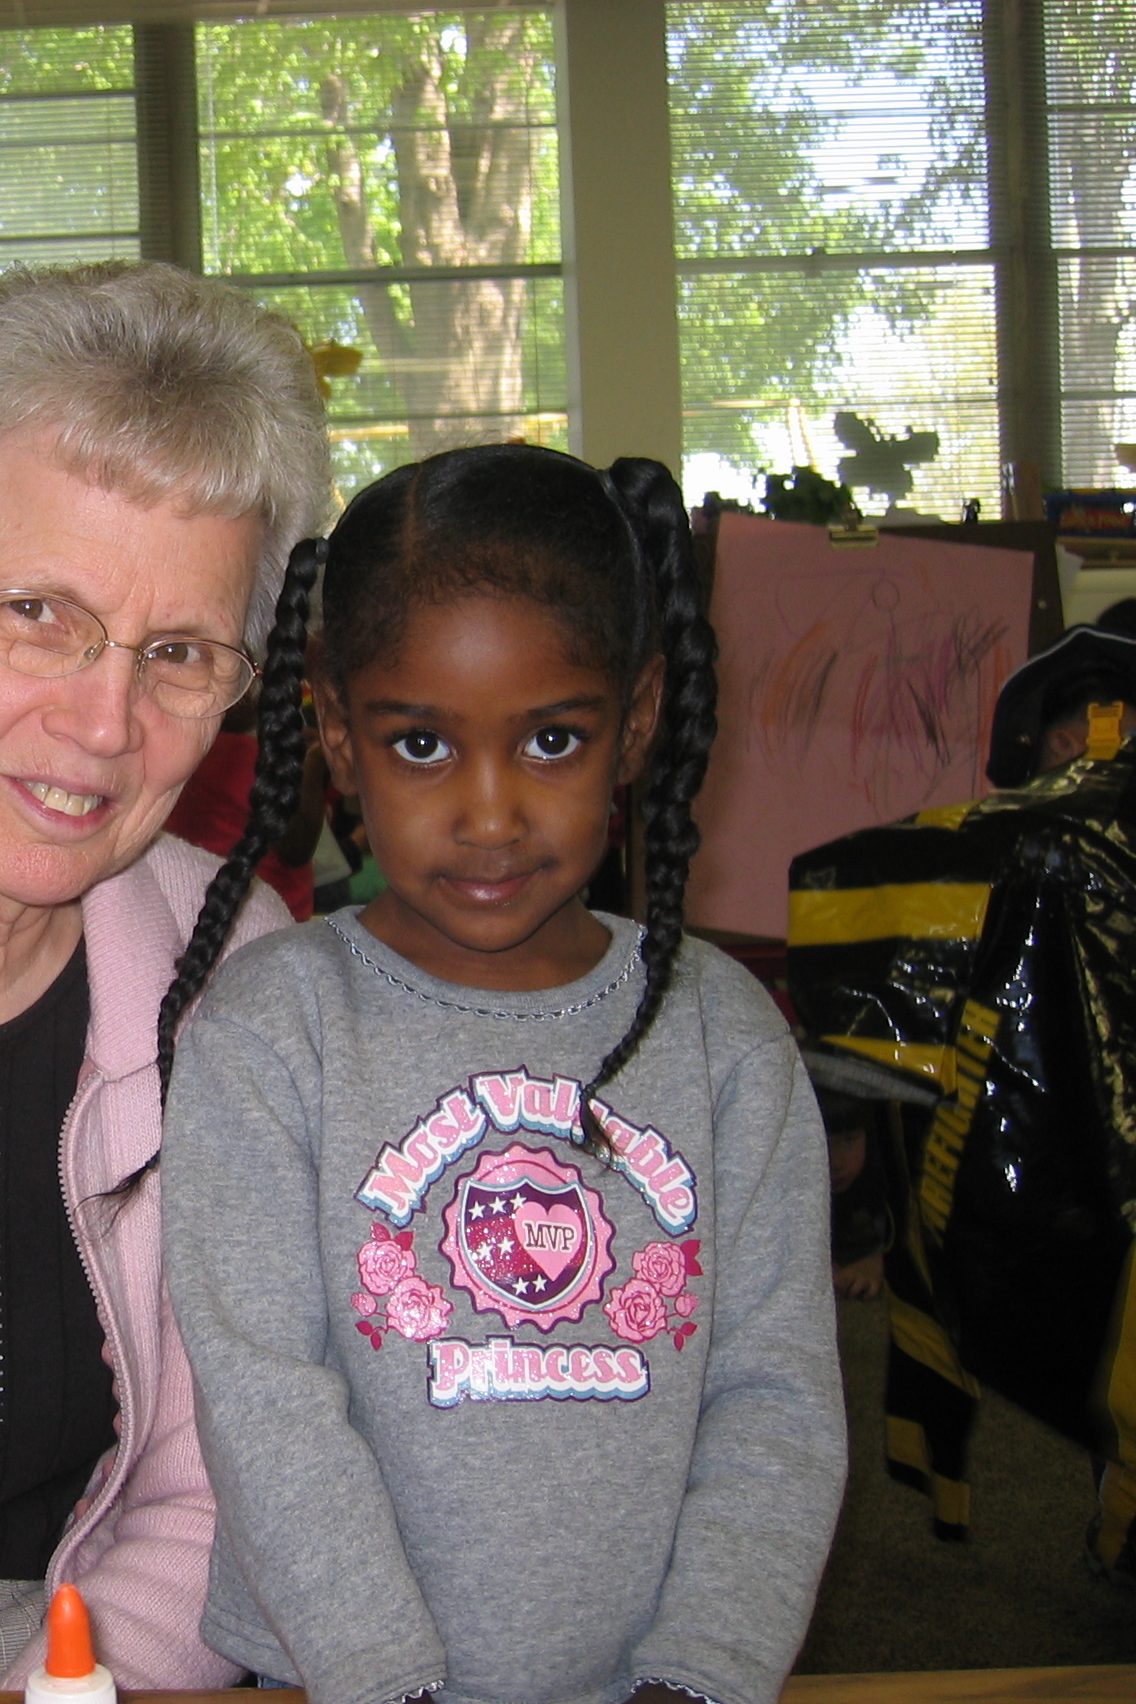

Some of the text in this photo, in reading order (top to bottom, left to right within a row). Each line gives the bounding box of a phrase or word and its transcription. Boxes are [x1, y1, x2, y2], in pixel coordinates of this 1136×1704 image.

[357, 1066, 696, 1234] Most Valable
[523, 1221, 577, 1252] MVP
[430, 1338, 649, 1406] Princess
